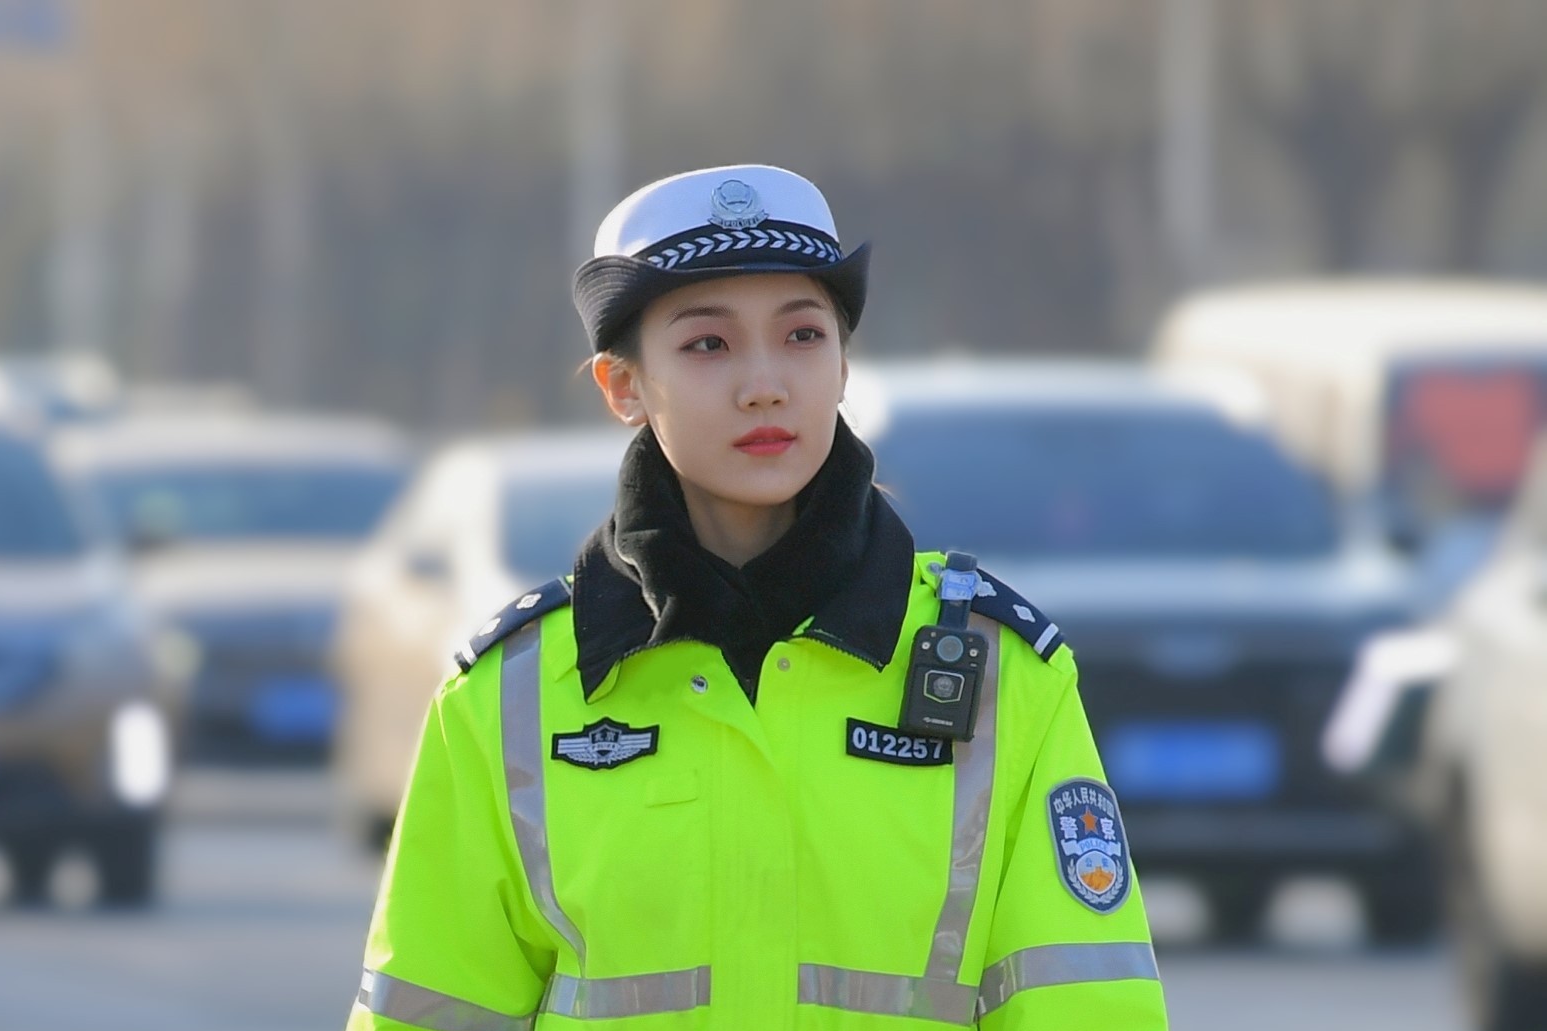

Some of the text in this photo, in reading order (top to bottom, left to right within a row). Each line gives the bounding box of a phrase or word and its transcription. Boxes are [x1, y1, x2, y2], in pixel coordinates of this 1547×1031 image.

[852, 727, 944, 759] 012257
[1053, 787, 1115, 819] 中华人民共和国
[1059, 816, 1116, 840] 警察
